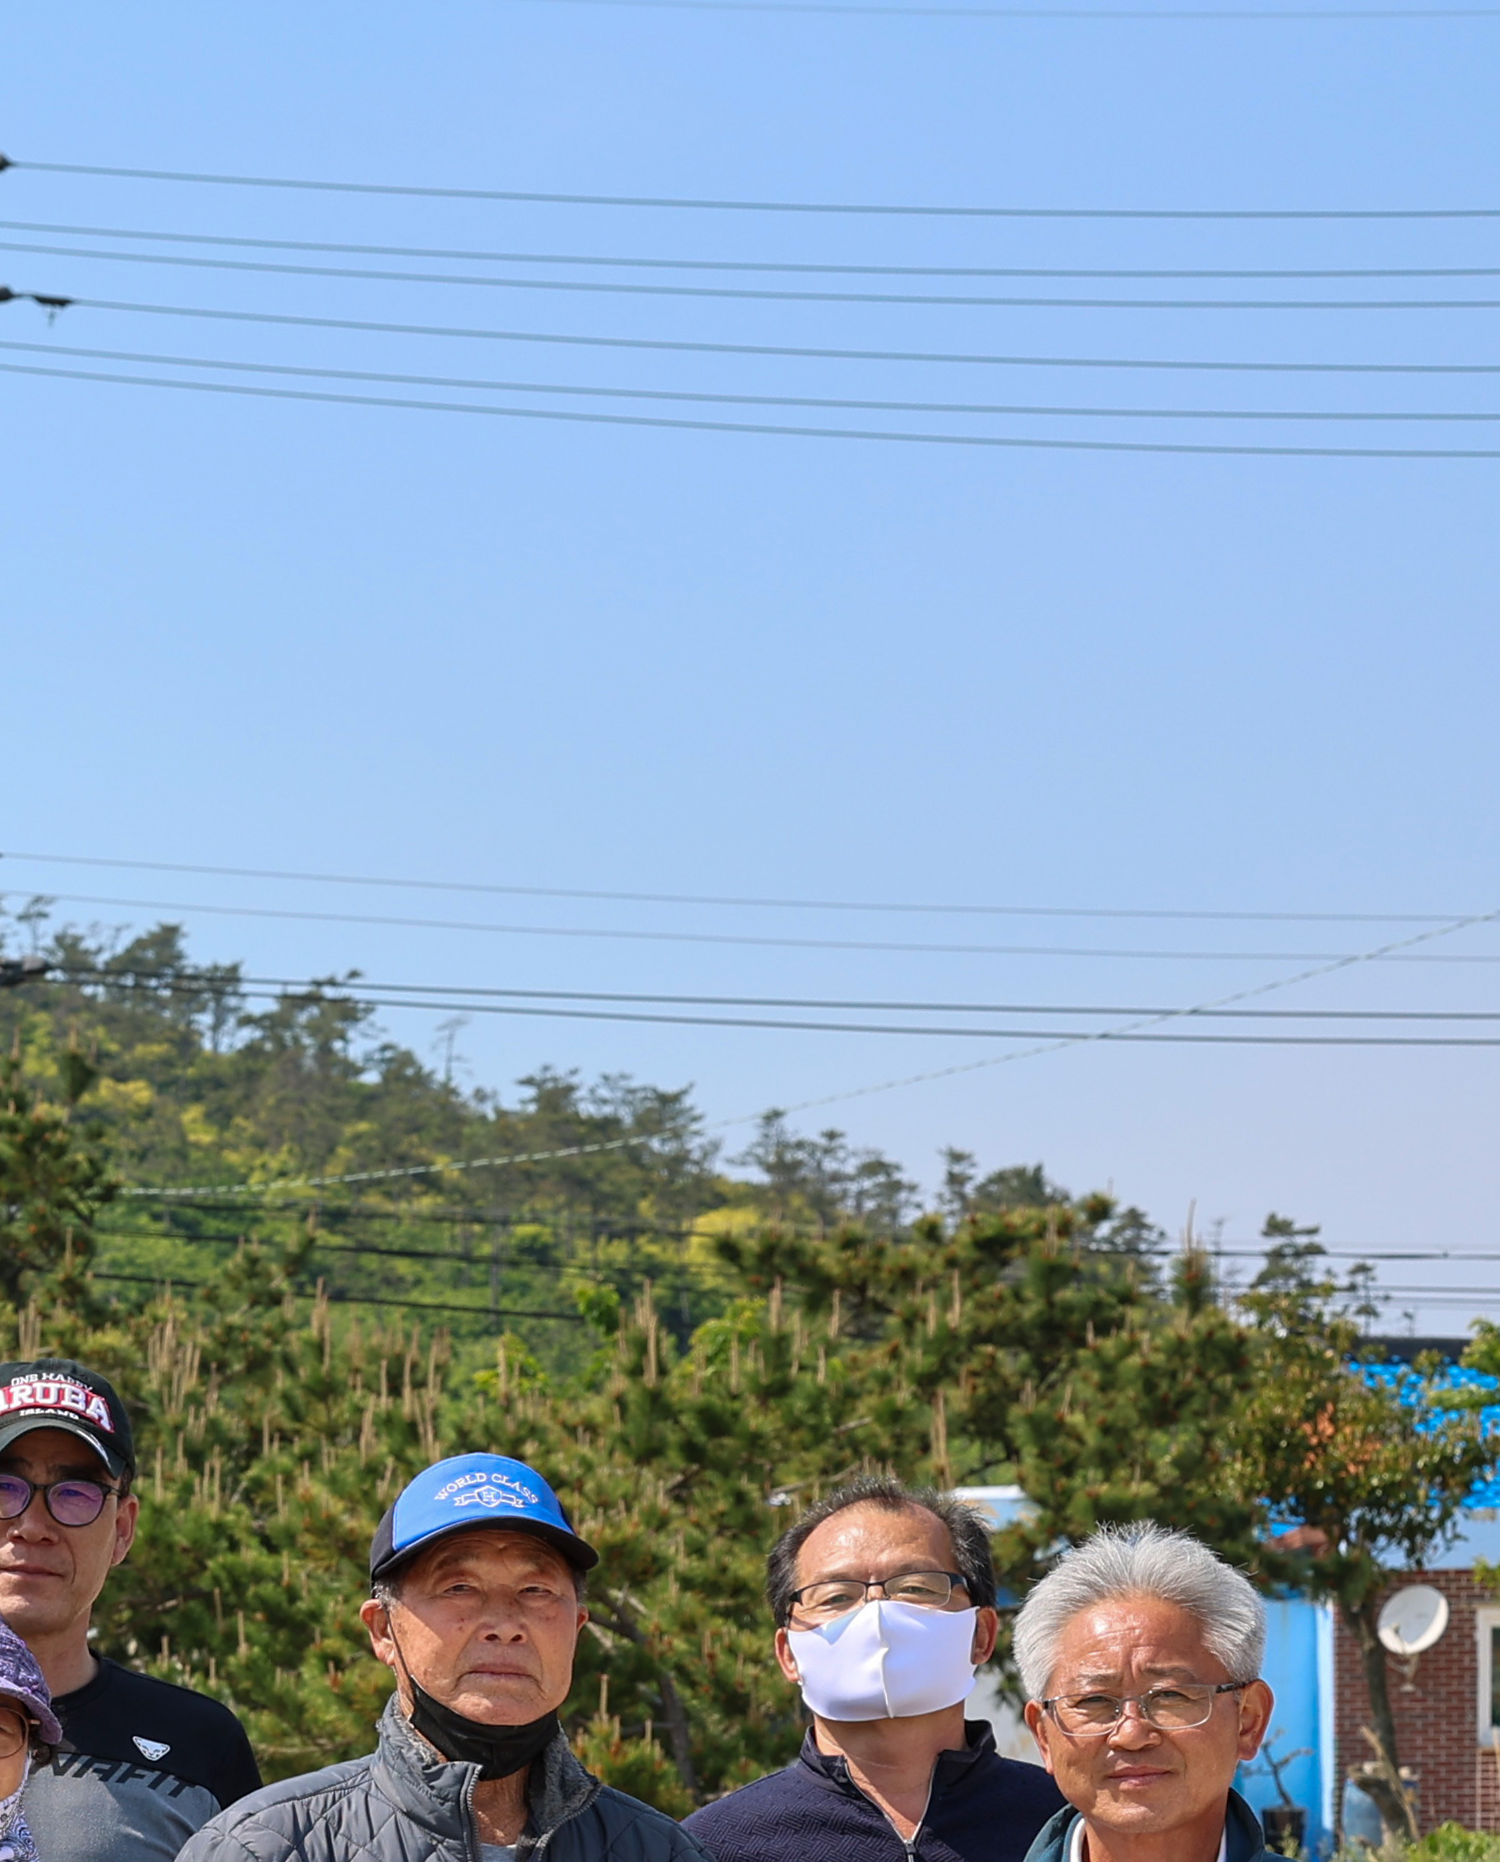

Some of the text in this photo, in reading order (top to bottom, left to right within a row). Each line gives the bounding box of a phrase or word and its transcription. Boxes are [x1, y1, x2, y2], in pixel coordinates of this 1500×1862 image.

[11, 1373, 38, 1387] ONE
[19, 1407, 79, 1420] ISLAND
[434, 1472, 539, 1504] WORLD CLASS
[49, 1752, 196, 1798] NAFIT
